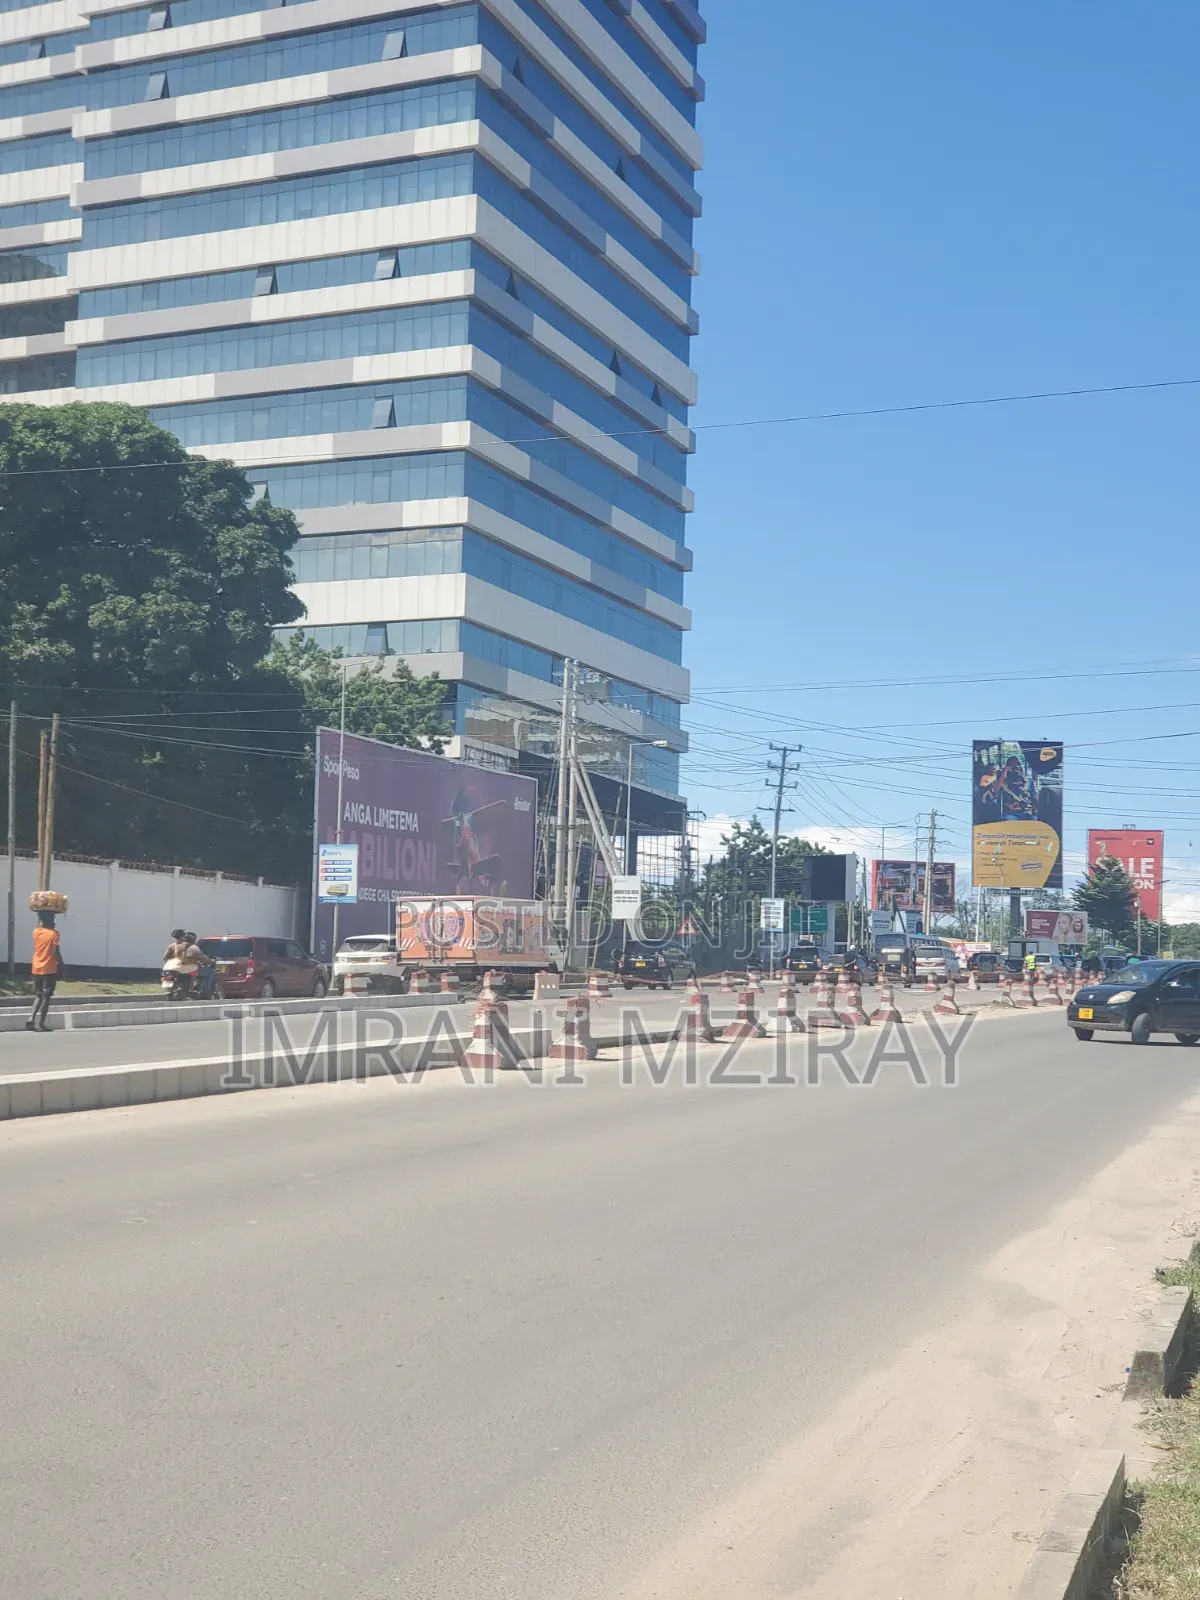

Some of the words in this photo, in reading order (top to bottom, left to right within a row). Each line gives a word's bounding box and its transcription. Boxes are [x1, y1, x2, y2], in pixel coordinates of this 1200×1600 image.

[323, 754, 360, 780] SporPesa
[343, 801, 373, 826] ANGA
[373, 806, 420, 833] LIMETEMA
